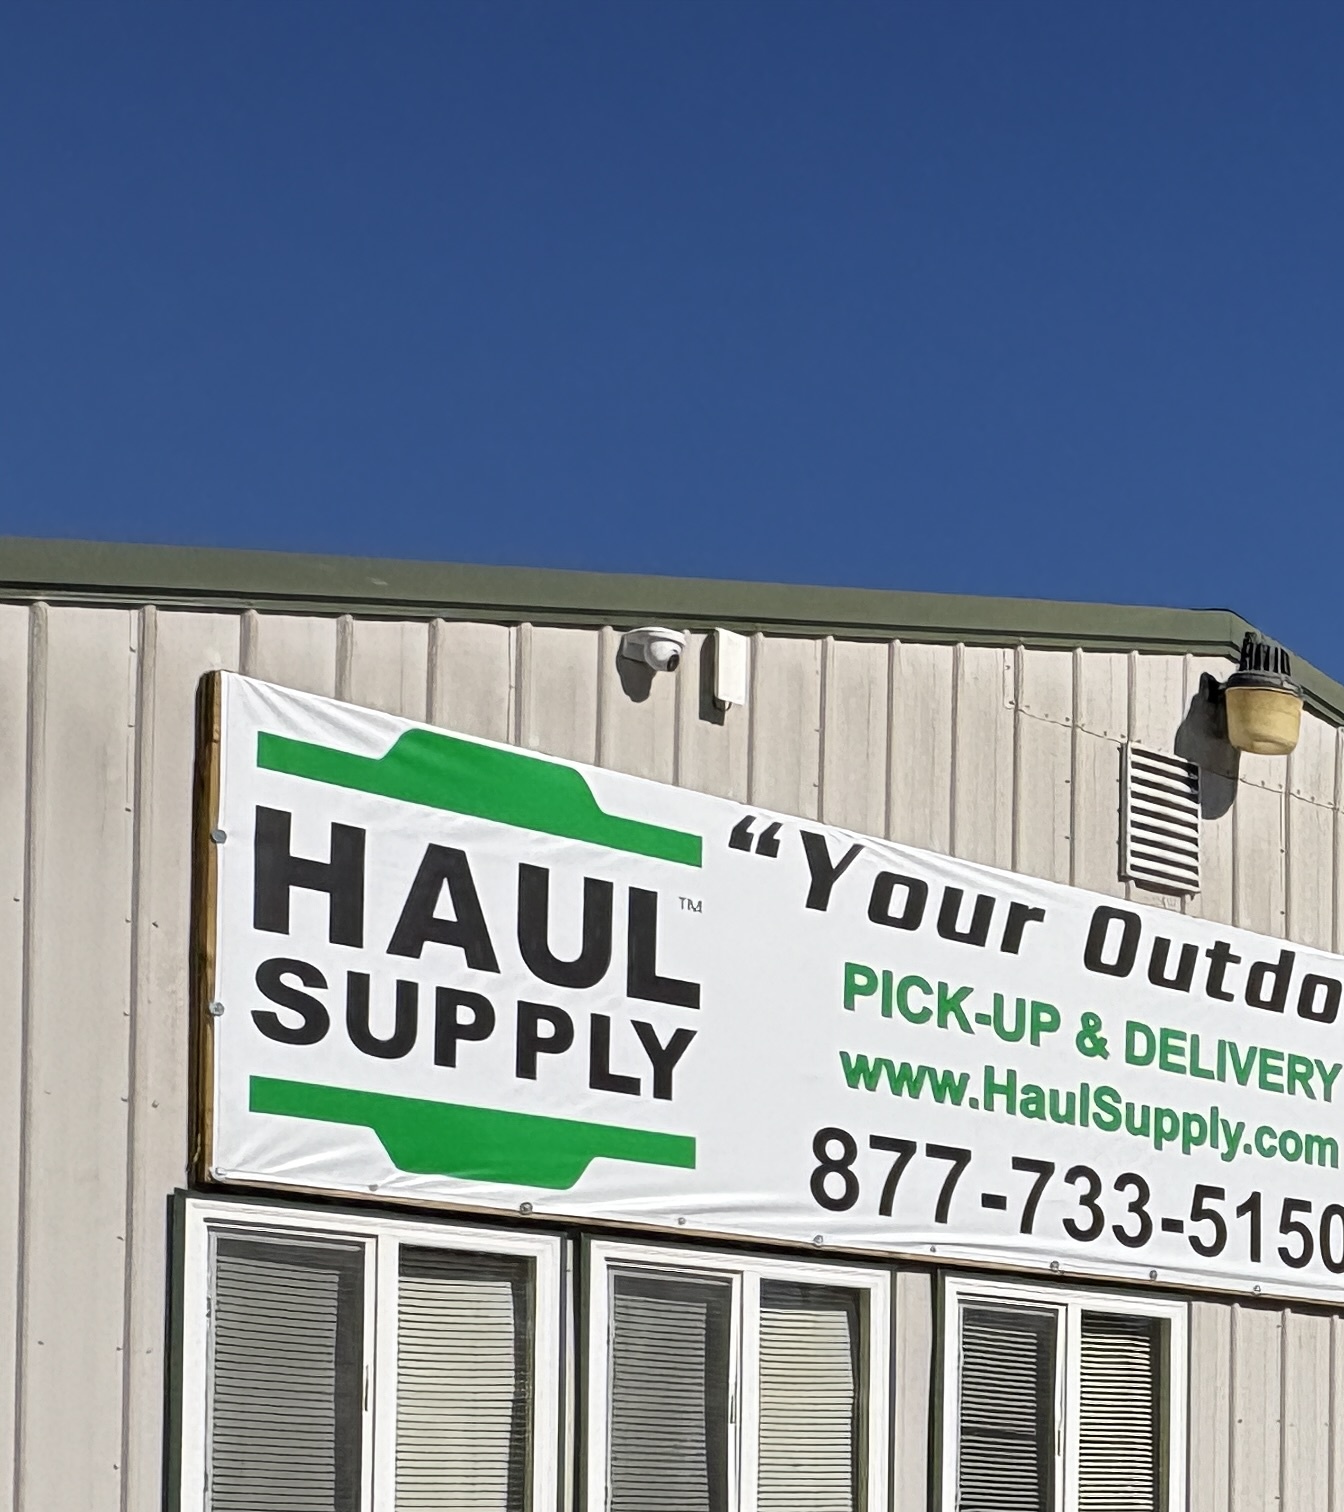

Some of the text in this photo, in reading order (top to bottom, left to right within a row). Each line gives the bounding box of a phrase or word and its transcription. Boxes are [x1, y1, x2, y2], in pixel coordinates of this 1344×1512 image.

[253, 804, 702, 1010] HAUL
[678, 895, 703, 914] TM
[250, 957, 698, 1101] SUPPLY
[844, 962, 1342, 1102] PICK-UP & DELIVERY
[839, 1050, 1340, 1169] www.HaulSupply.com
